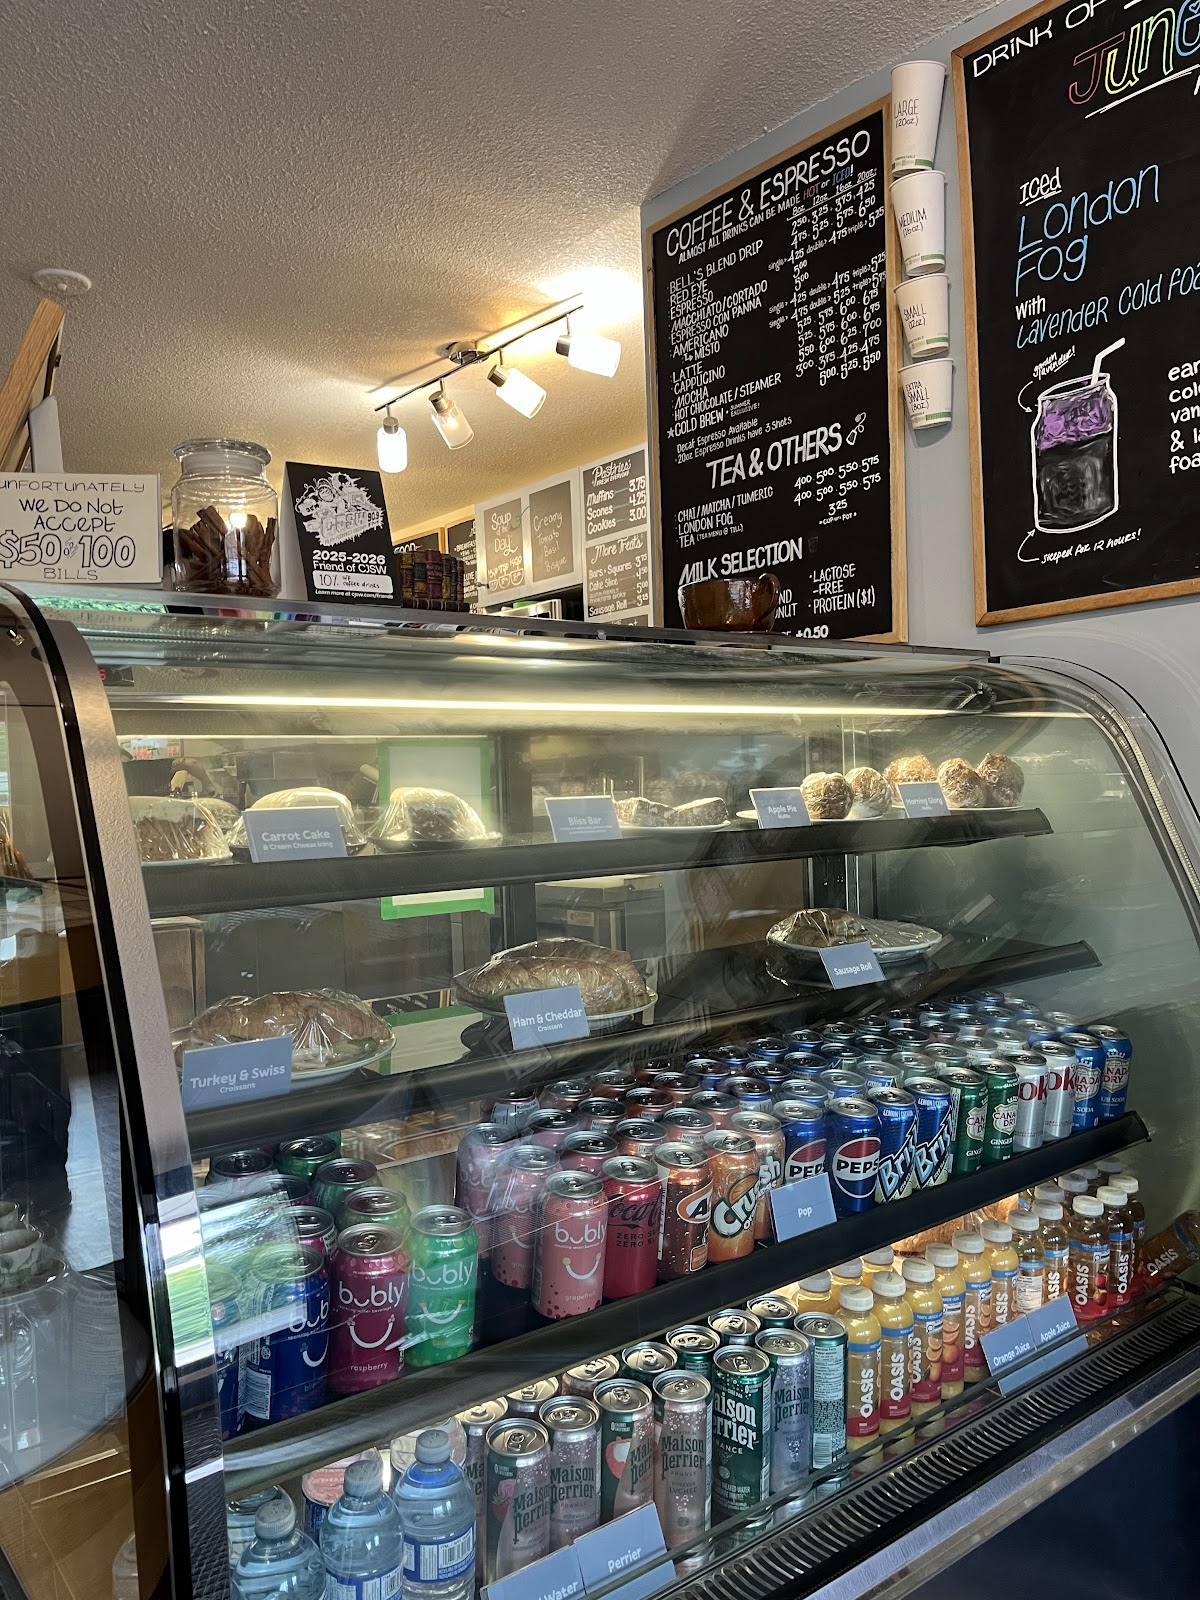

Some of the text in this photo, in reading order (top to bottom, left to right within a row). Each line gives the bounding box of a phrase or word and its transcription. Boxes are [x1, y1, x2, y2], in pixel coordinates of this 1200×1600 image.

[893, 98, 919, 119] LARGE
[666, 130, 870, 257] COFFEE & ESPRESSO
[792, 180, 853, 216] 8oz 12oz 16oz
[678, 164, 854, 264] ALMOST ALL DRINKS CAN BE MADE HOT or ICED!
[898, 207, 928, 230] MEDIUM
[1018, 164, 1159, 253] London
[706, 252, 737, 277] BLEND
[739, 239, 764, 261] DRIP
[1015, 234, 1088, 297] Fog
[670, 279, 709, 306] RED EYE
[670, 290, 714, 320] ESPRESSO
[903, 303, 927, 322] SMALL
[1015, 295, 1046, 321] With
[671, 296, 762, 346] ESPRESSO CON PANNA
[672, 323, 729, 358] AMERICANO
[694, 340, 720, 361] MISTO
[672, 360, 703, 383] LATTE
[674, 365, 726, 395] CAPPUCINO
[674, 386, 709, 410] MOCHA
[905, 380, 923, 393] EXTRA
[907, 387, 930, 405] SMALL
[674, 407, 724, 437] COLD BREW
[676, 418, 758, 454] Decaf Espresso Available
[694, 441, 725, 459] Espresso
[725, 433, 746, 448] Drinks
[747, 427, 763, 440] have
[765, 423, 771, 433] 3
[771, 416, 793, 431] Shots
[705, 422, 843, 489] TEA & OTHERS
[586, 475, 646, 507] Muffins 3.75
[18, 498, 124, 515] We Do Not
[586, 490, 646, 520] Scones 4.25
[34, 515, 116, 532] Accept
[491, 512, 512, 531] Soup
[533, 512, 563, 532] Creamy
[587, 506, 647, 535] Cookies 3.00
[678, 511, 734, 536] LONDON FOG
[0, 529, 62, 569] $50
[78, 535, 136, 569] 100
[537, 529, 560, 546] Tomato
[543, 540, 560, 557] Basil
[679, 533, 696, 549] TEA
[312, 549, 386, 565] 2025-2026
[590, 534, 643, 565] More Treats
[312, 560, 387, 575] Friend of CJSW
[545, 556, 567, 572] Bisque
[588, 561, 632, 580] Bars Squares
[679, 537, 803, 586] MILK SELECTION
[812, 563, 857, 583] LACTOSE
[43, 568, 99, 581] BILLS
[319, 573, 339, 587] 10%
[342, 580, 380, 589] coffee drinks
[588, 581, 604, 592] Cake
[588, 599, 628, 617] Sausage Roll
[812, 590, 856, 615] PROTEIN
[856, 585, 876, 609] ($1)
[768, 804, 797, 814] Apple Pie
[905, 797, 943, 806] Morning Glory
[568, 816, 602, 826] Bliss Bar
[261, 829, 331, 842] Carrot Cake
[269, 843, 292, 851] Cream
[317, 840, 334, 849] Icing
[833, 961, 873, 976] Sausage Roll
[512, 1008, 583, 1028] Ham & Cheddar
[537, 1022, 563, 1032] Croissant
[190, 1064, 286, 1089] Turkey & Swiss
[220, 1082, 256, 1094] Croissant
[836, 1158, 879, 1174] PEPS
[797, 1206, 813, 1218] Pop
[616, 1232, 644, 1240] ZERO
[411, 1260, 474, 1286] bubly
[1117, 1253, 1130, 1294] OASIS
[1147, 1248, 1179, 1277] OASIS
[338, 1281, 405, 1308] bubly
[1075, 1264, 1090, 1306] OASIS
[964, 1304, 976, 1350] OASIS
[1040, 1320, 1071, 1343] Apple Juice
[911, 1337, 922, 1384] OASIS
[993, 1341, 1031, 1367] Orange Juice
[350, 1362, 388, 1374] raspberry
[890, 1352, 905, 1403] OASIS
[860, 1367, 875, 1418] OASIS
[661, 1434, 704, 1453] Maison
[550, 1465, 594, 1484] Maison
[607, 1546, 642, 1573] Perrier
[543, 1580, 579, 1600] Water
